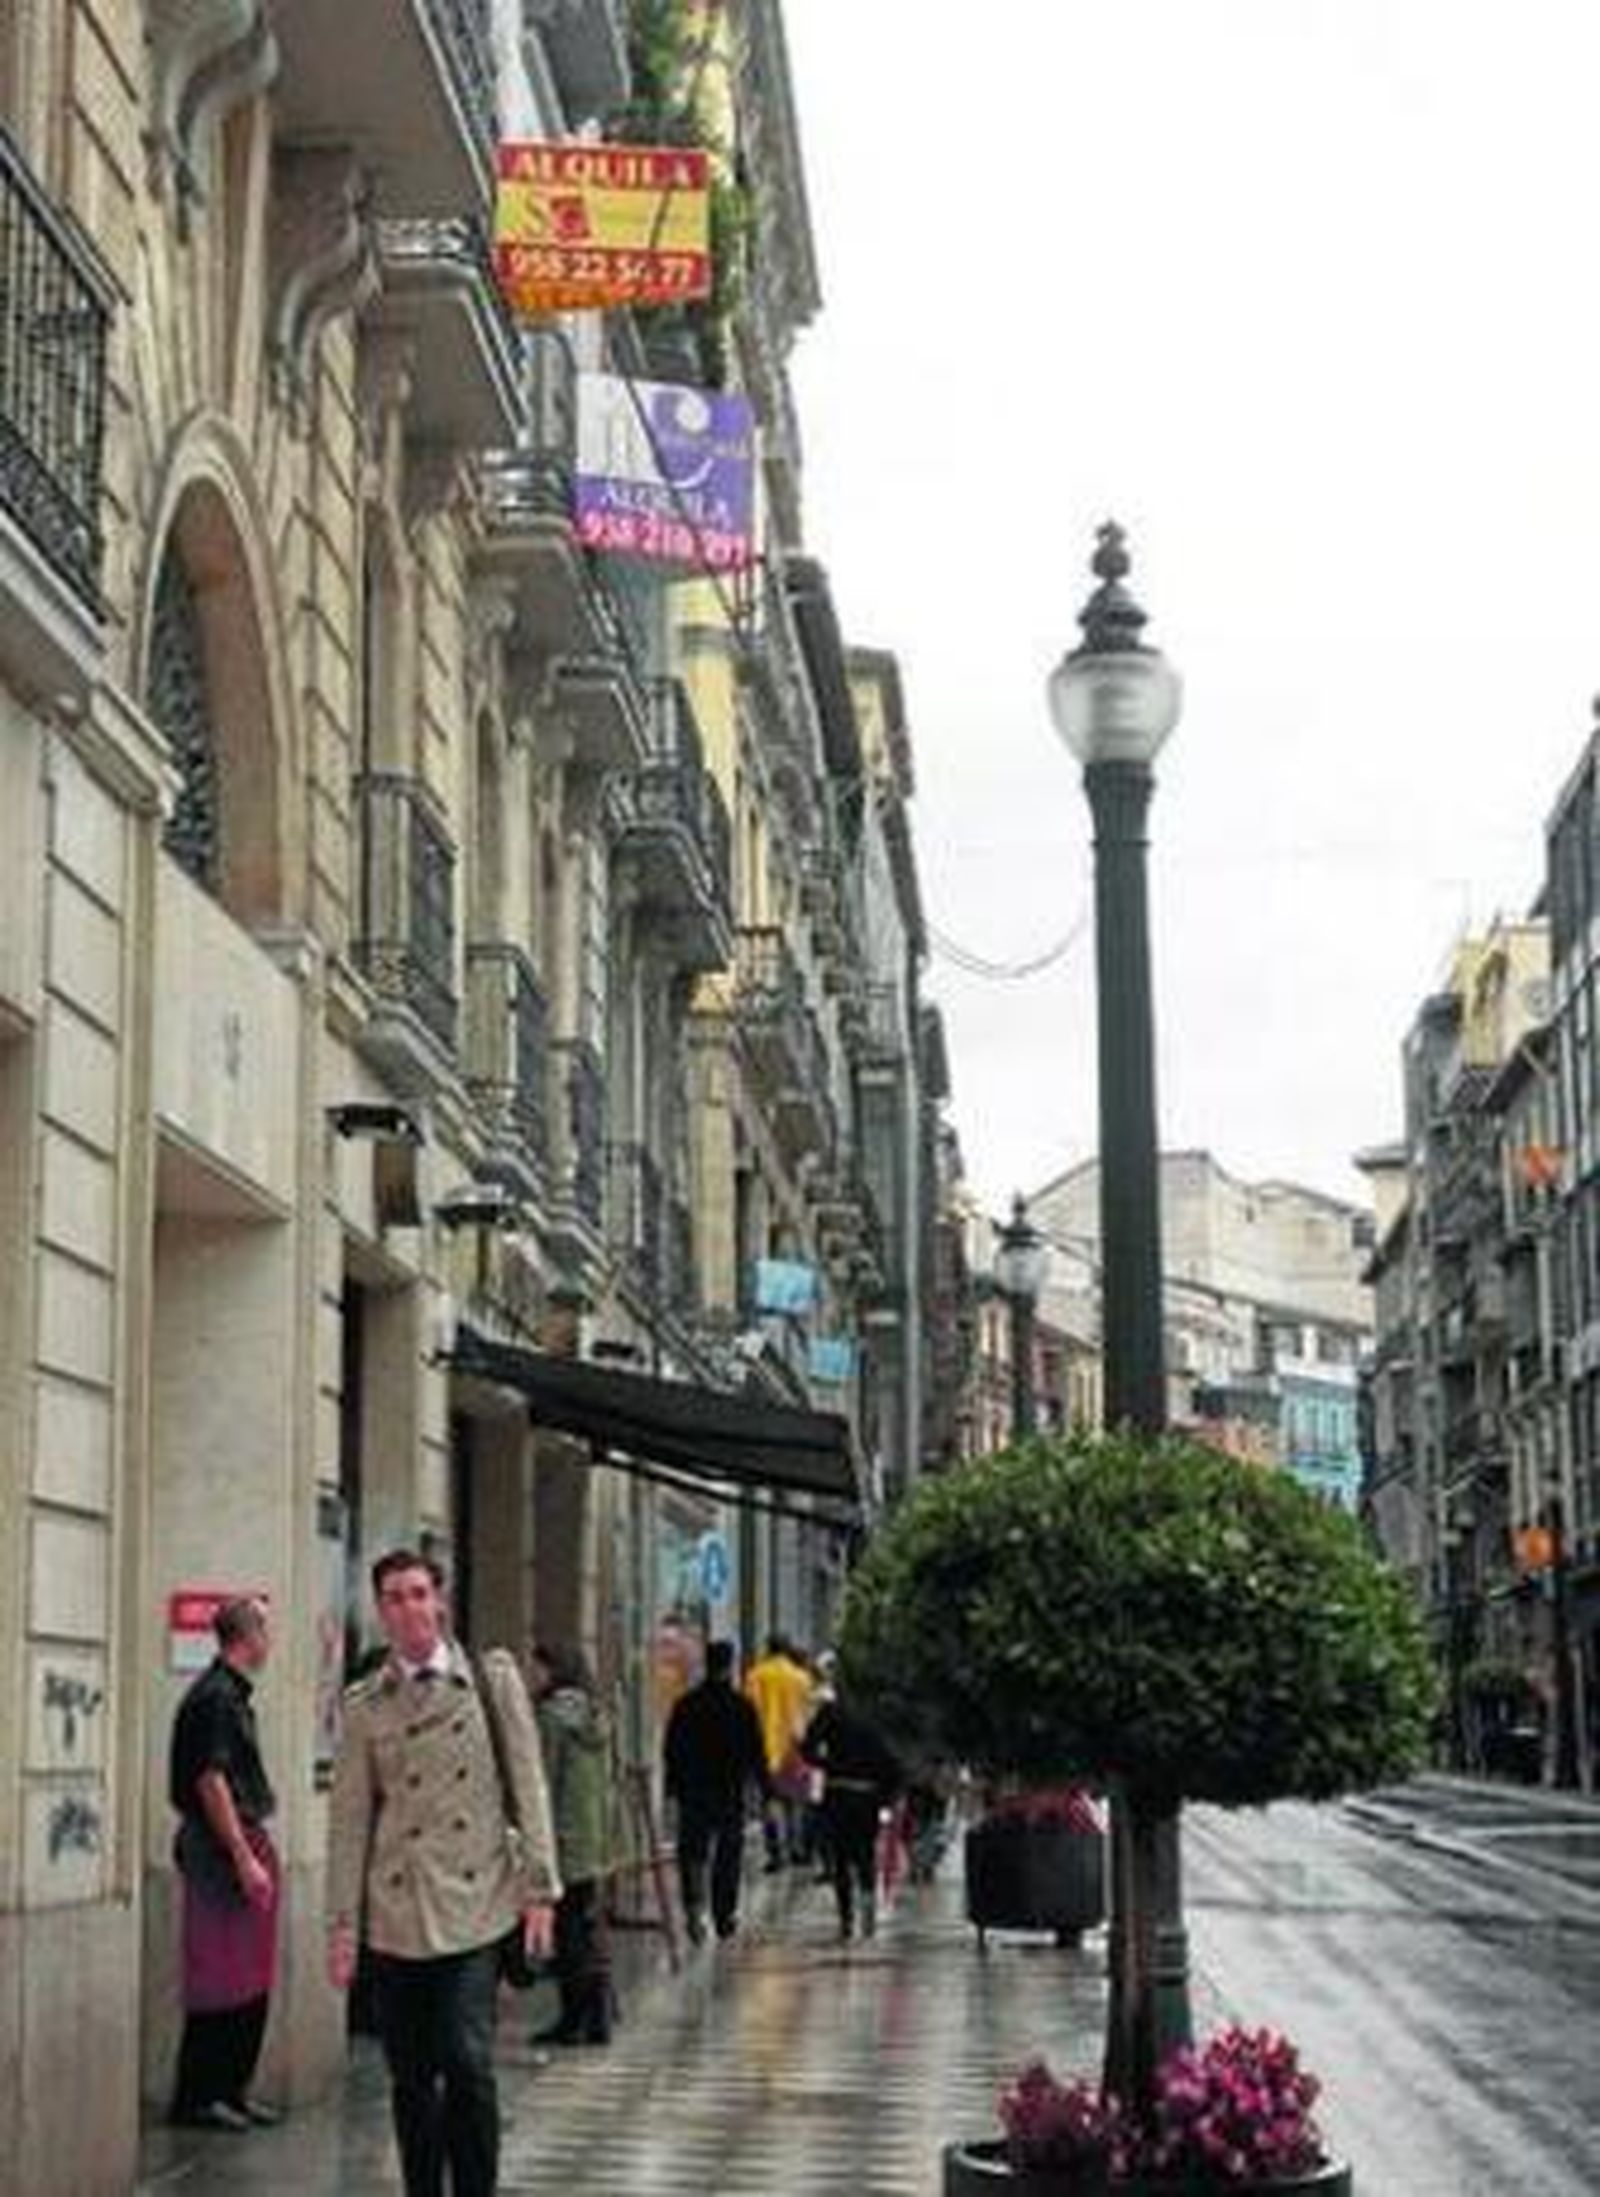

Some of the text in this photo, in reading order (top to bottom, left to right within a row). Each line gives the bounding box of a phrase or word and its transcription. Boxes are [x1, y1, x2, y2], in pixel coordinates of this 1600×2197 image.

[512, 150, 693, 190] ALQUILA
[509, 249, 566, 279] 958
[571, 253, 608, 280] 22
